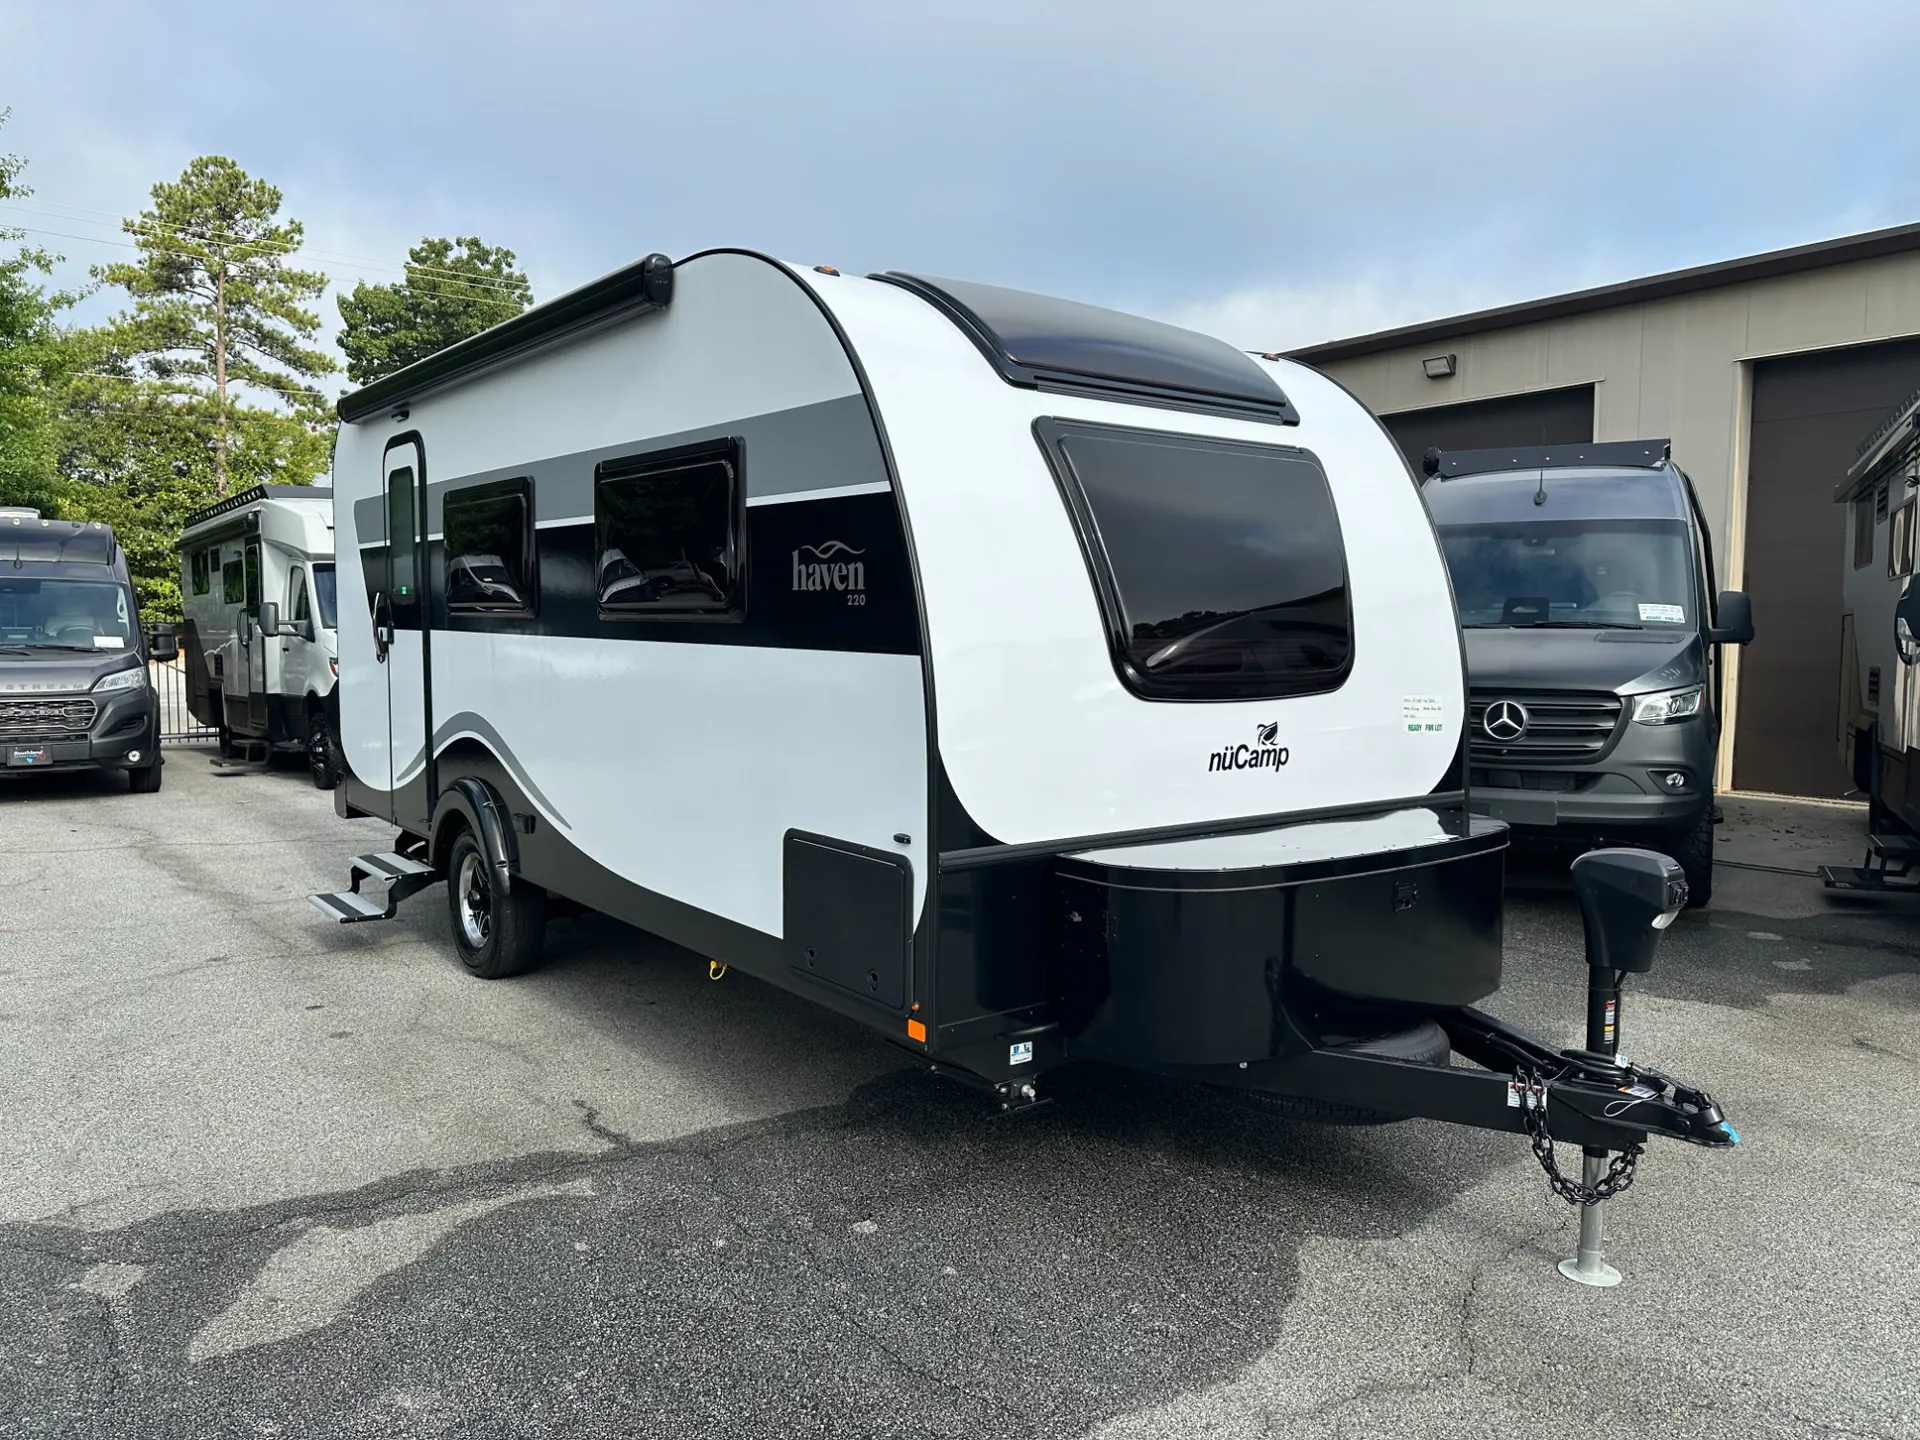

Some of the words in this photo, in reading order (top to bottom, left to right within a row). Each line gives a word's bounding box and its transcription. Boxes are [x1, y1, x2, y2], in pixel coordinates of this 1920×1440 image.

[792, 549, 866, 591] haven
[847, 594, 866, 606] 220
[1208, 743, 1290, 772] nüCamp
